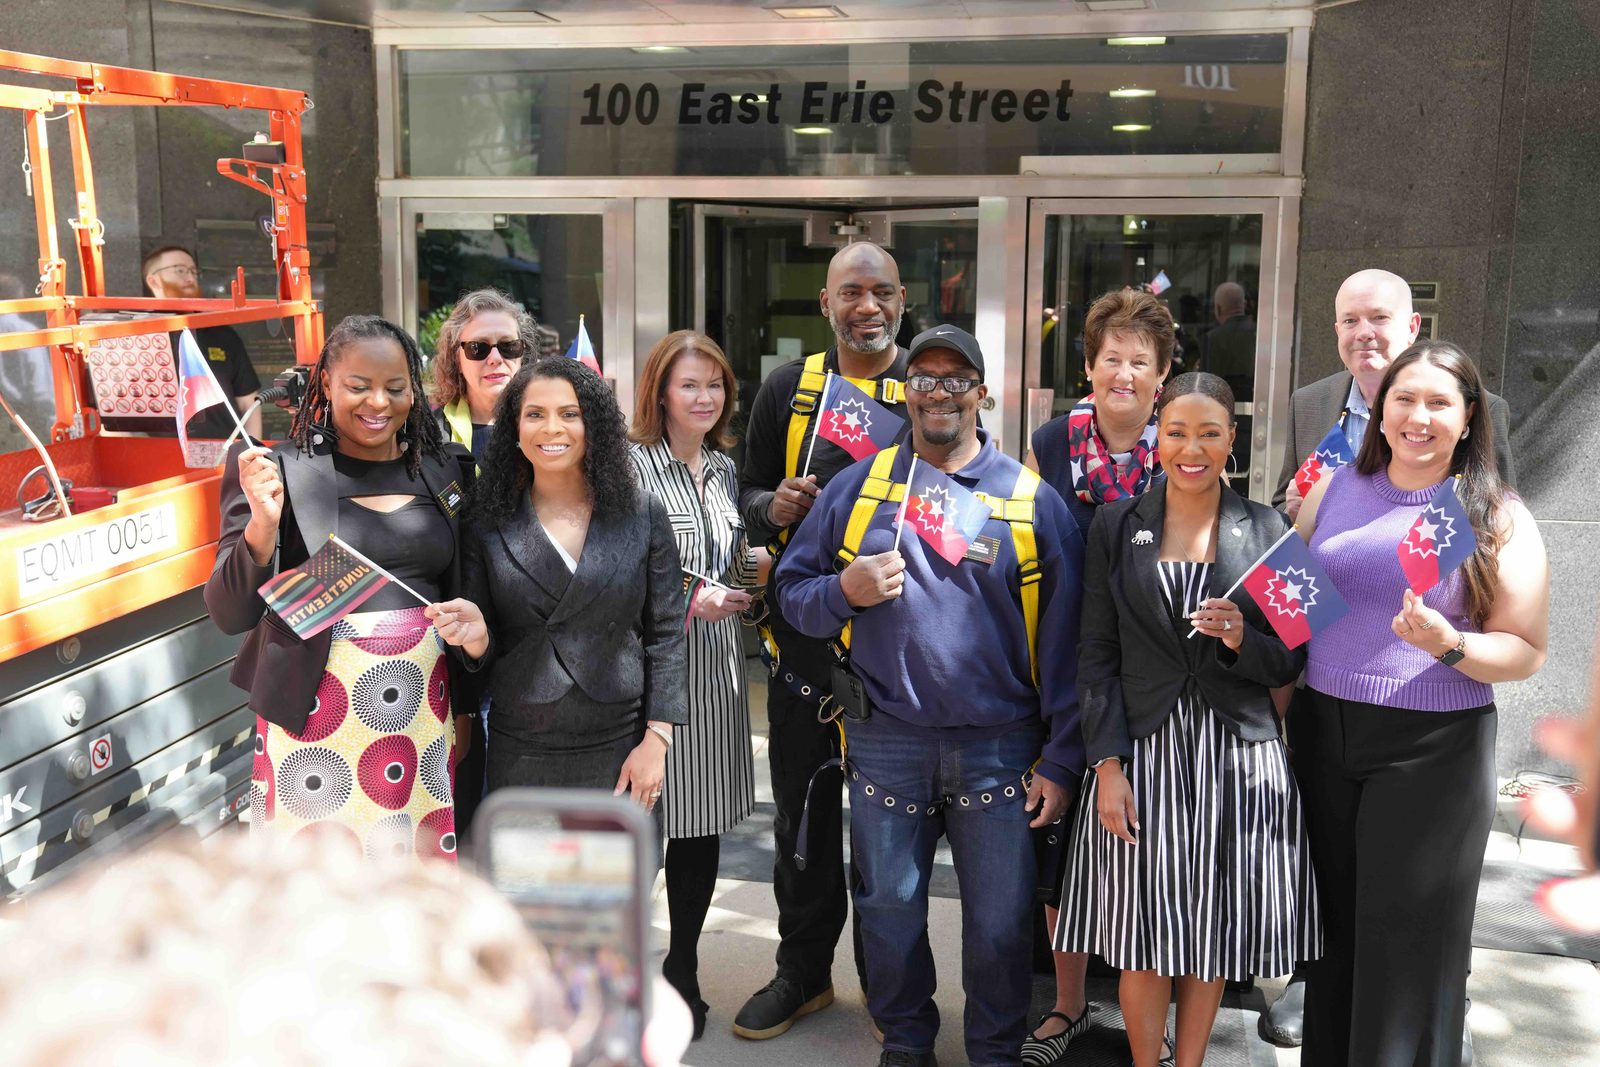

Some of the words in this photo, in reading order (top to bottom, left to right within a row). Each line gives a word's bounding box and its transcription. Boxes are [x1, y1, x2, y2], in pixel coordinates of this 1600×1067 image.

[580, 83, 660, 126] 100
[678, 83, 782, 125] East
[801, 80, 895, 124] Erie
[914, 79, 1073, 123] Street
[23, 529, 97, 583] EQMT
[107, 509, 168, 555] 0051
